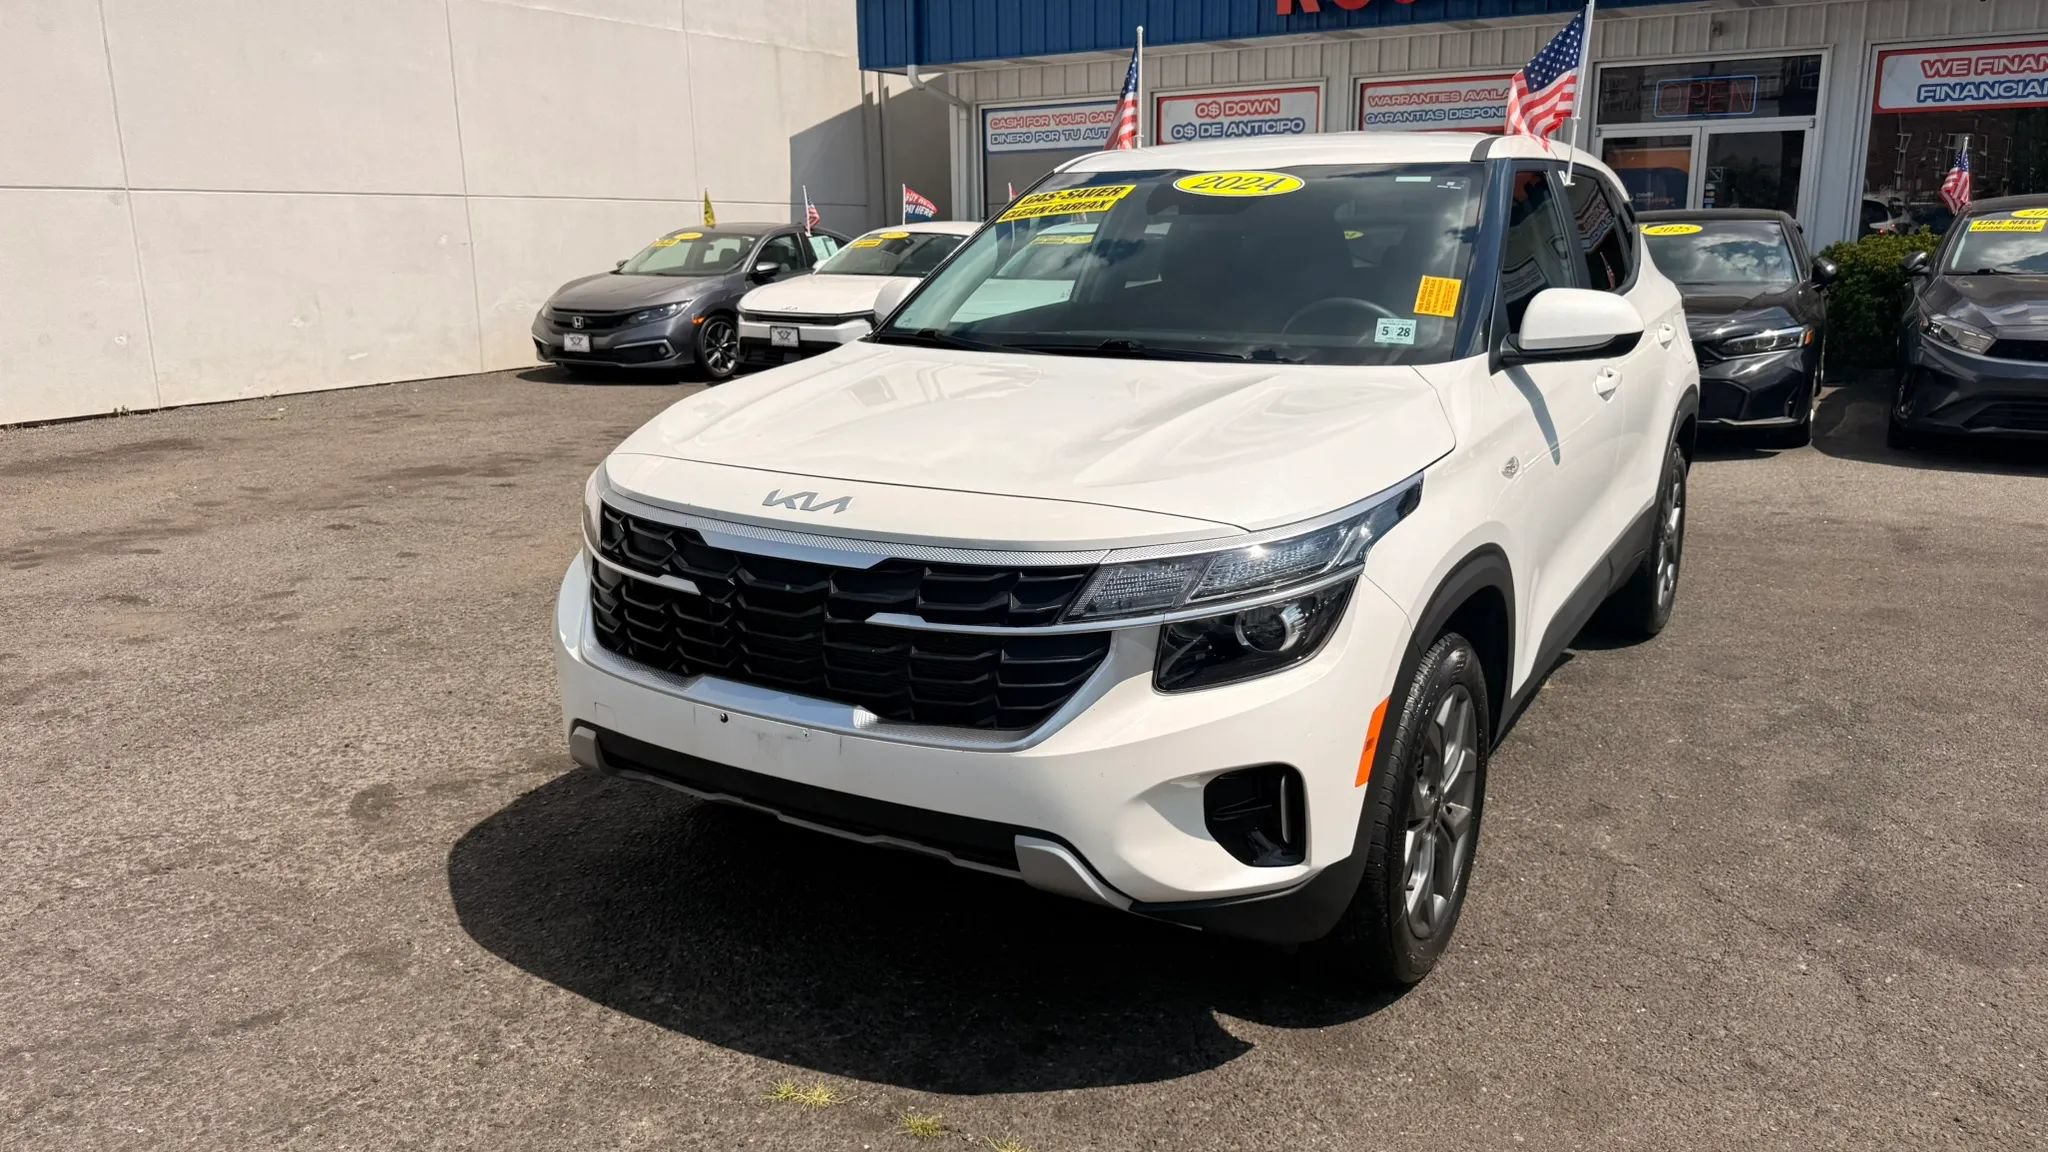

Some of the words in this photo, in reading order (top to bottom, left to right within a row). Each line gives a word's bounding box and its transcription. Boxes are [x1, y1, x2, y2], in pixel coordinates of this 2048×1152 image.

[1921, 57, 1971, 78] WE
[1223, 98, 1280, 115] DOWN
[1369, 92, 1460, 107] WARRANTIES
[1660, 81, 1754, 112] OPEN
[991, 115, 1024, 130] CASH
[1025, 115, 1050, 128] FOR
[1052, 111, 1087, 126] YOUR
[1088, 110, 1115, 123] CAR
[1366, 110, 1445, 124] GARANTIAS
[1447, 105, 1507, 120] DISPONI
[991, 131, 1033, 145] DINERO
[1034, 128, 1061, 143] POR
[1062, 127, 1082, 140] TU
[1083, 127, 1110, 140] AUT
[1199, 121, 1223, 138] DE
[1224, 117, 1306, 137] ANTICIPO
[1191, 176, 1287, 191] 2024
[1021, 186, 1127, 206] GAS-SAVER
[1002, 205, 1050, 221] CLEAN
[1047, 198, 1109, 214] CARFAX
[1381, 326, 1389, 336] 5
[1396, 327, 1411, 337] 28
[762, 489, 853, 514] KIA
